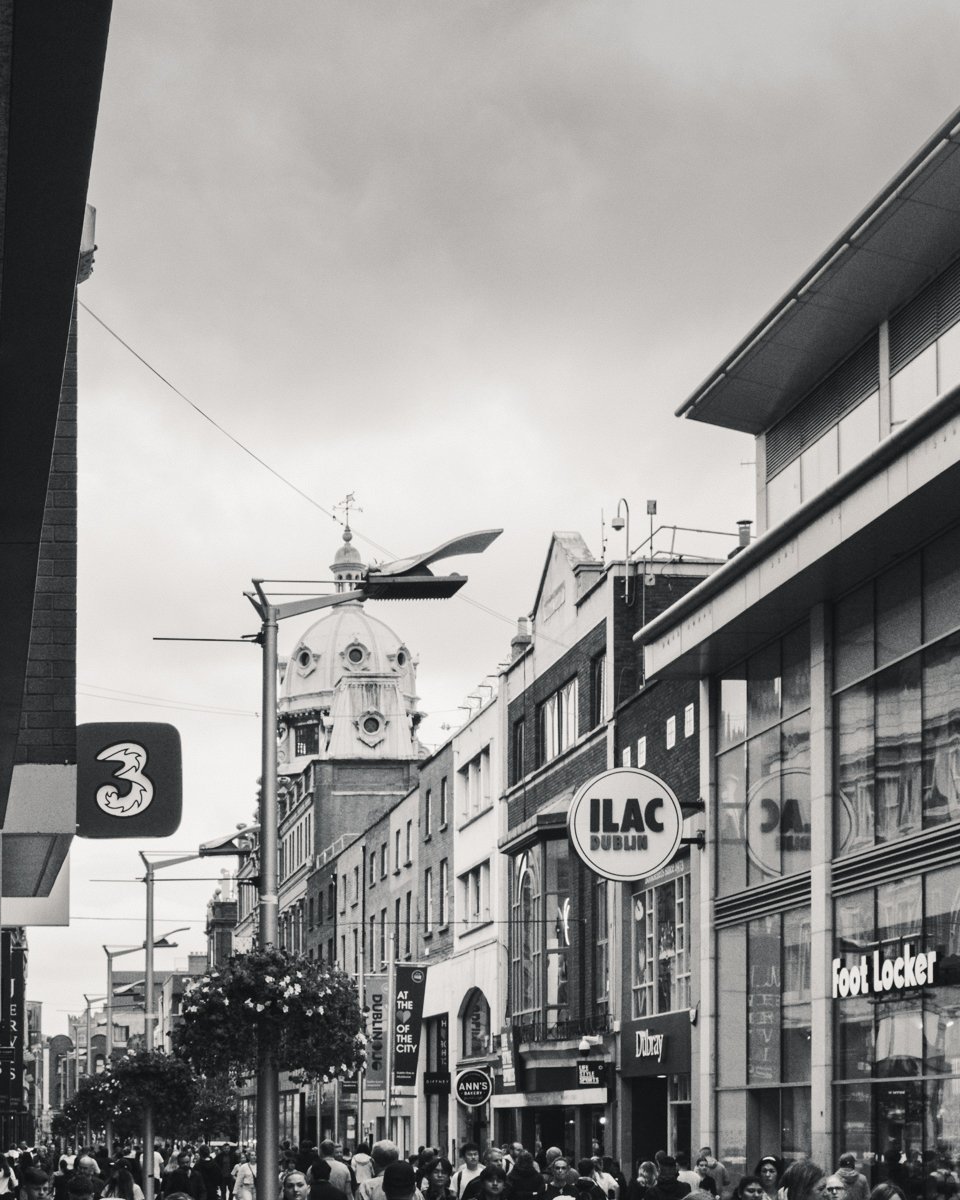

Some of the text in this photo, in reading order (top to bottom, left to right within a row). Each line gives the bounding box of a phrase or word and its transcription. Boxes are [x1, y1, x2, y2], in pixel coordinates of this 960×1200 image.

[95, 742, 154, 817] 3
[590, 798, 664, 832] ILAC
[590, 834, 648, 851] DUBLIN
[833, 943, 937, 998] Foot Locker
[397, 991, 409, 999] AT
[396, 1001, 413, 1010] THE
[372, 994, 382, 1040] DUBLIN
[9, 978, 19, 1080] JERVS
[396, 1024, 410, 1033] OF
[396, 1034, 413, 1043] THE
[635, 1028, 664, 1063] Dubray
[396, 1044, 417, 1053] CITY
[459, 1082, 488, 1090] ANN'S
